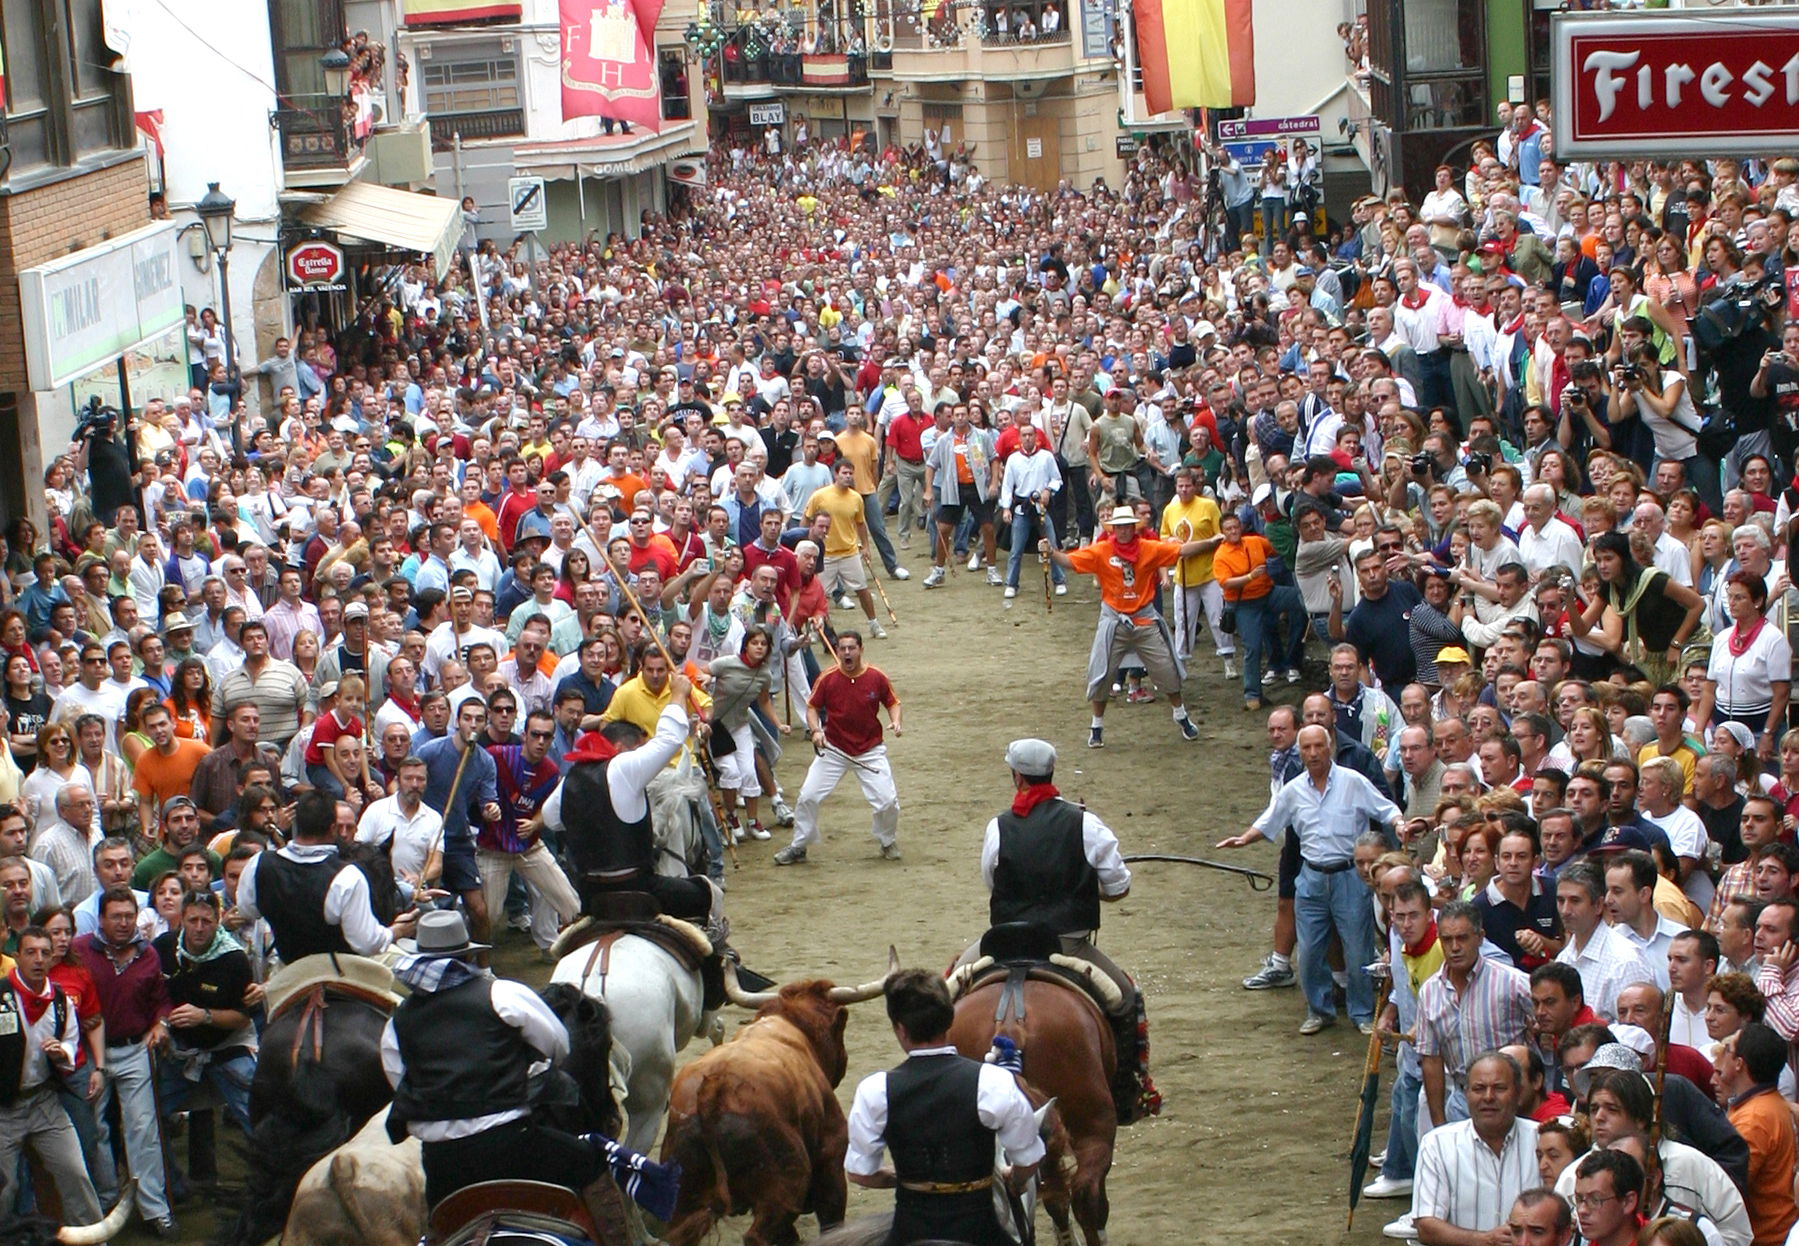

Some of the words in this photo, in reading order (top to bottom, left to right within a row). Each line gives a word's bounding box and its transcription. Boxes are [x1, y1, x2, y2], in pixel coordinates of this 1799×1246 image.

[566, 25, 581, 52] F
[601, 62, 622, 86] H
[752, 112, 781, 122] BLAY
[1278, 119, 1318, 130] catedral
[298, 256, 332, 267] Estrella
